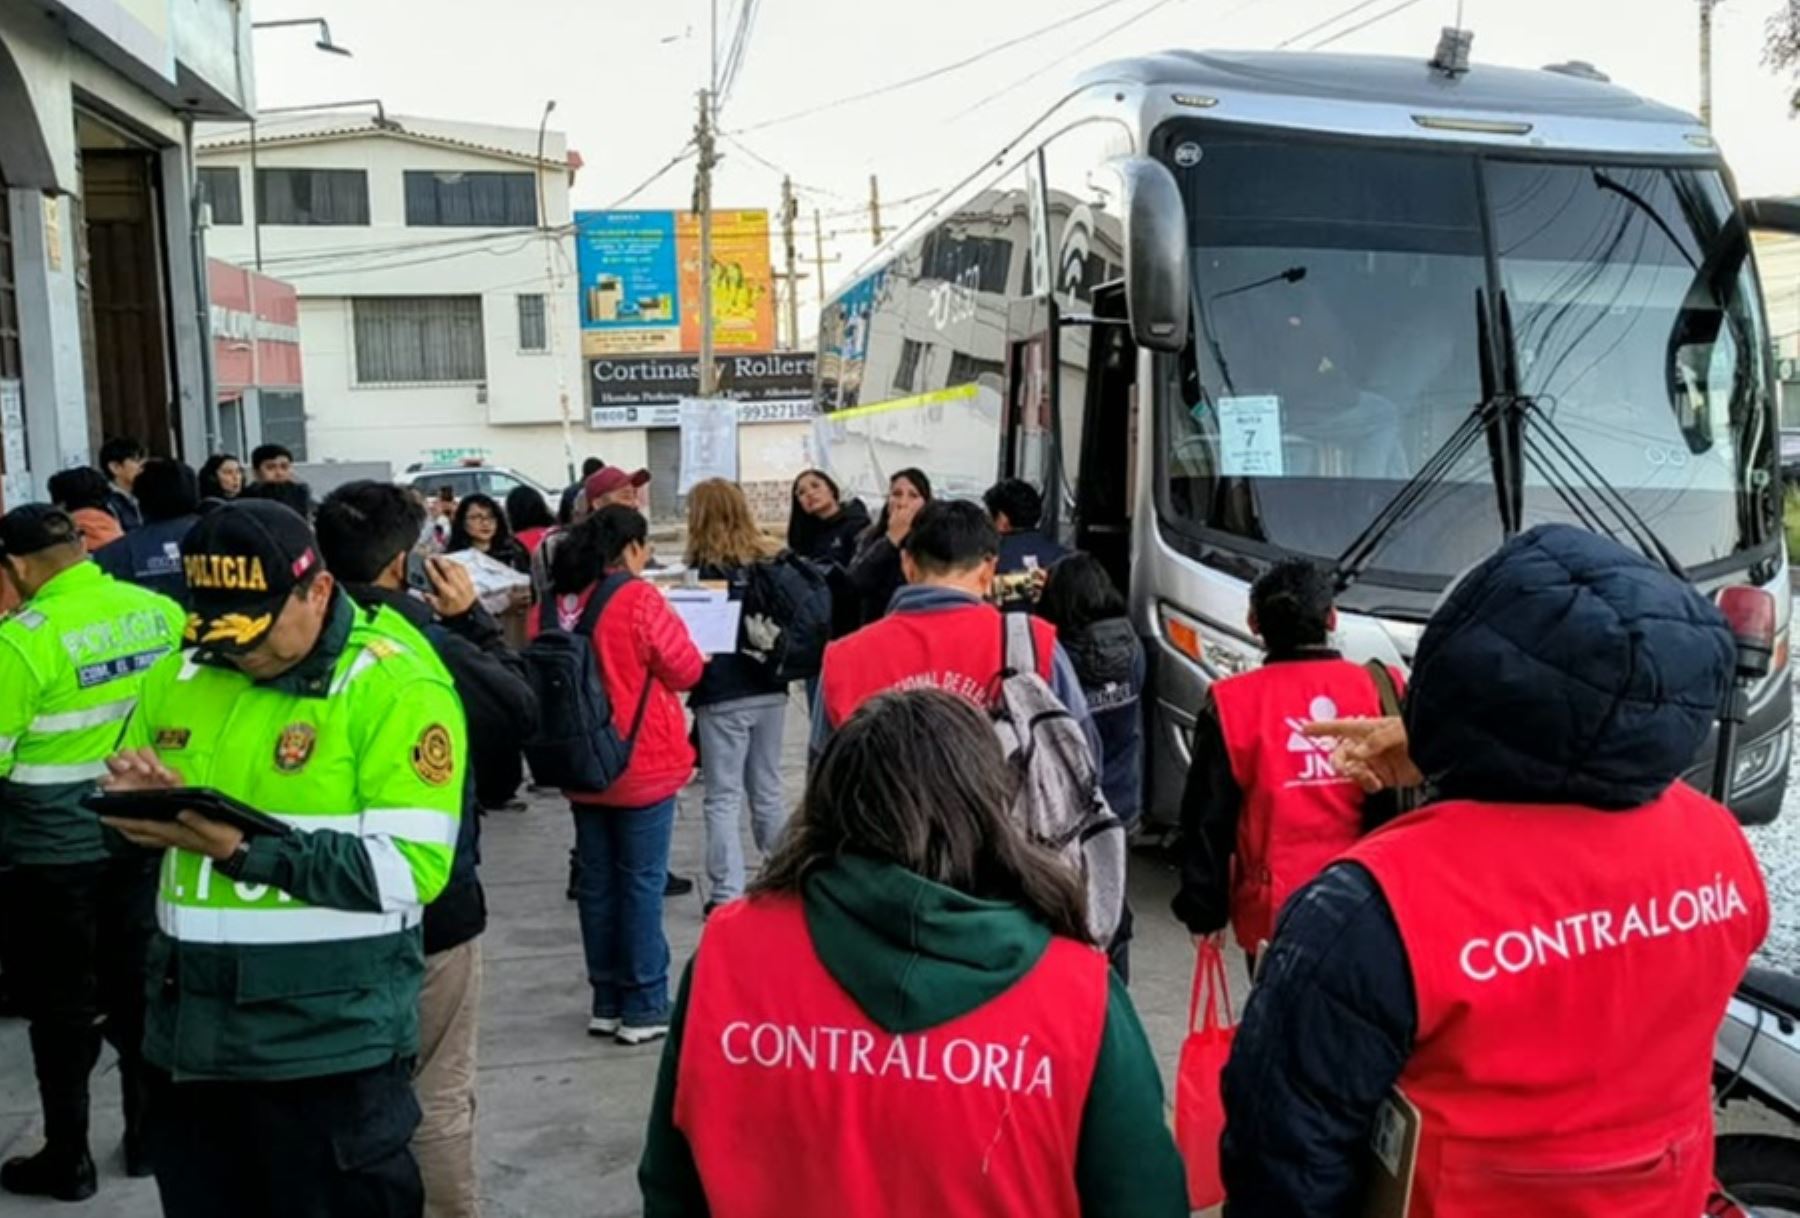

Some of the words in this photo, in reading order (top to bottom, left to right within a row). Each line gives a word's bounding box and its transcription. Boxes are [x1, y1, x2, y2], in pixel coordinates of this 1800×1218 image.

[594, 360, 700, 381] Cortinas
[735, 356, 815, 377] Rollers
[1244, 429, 1256, 448] 7
[62, 609, 170, 662] POLICIA
[895, 671, 940, 691] IONAL
[944, 671, 962, 691] DE
[1299, 753, 1336, 778] JN
[1459, 872, 1747, 981] CONTRALORÍA
[721, 1021, 1053, 1098] CONTRALORÍA
